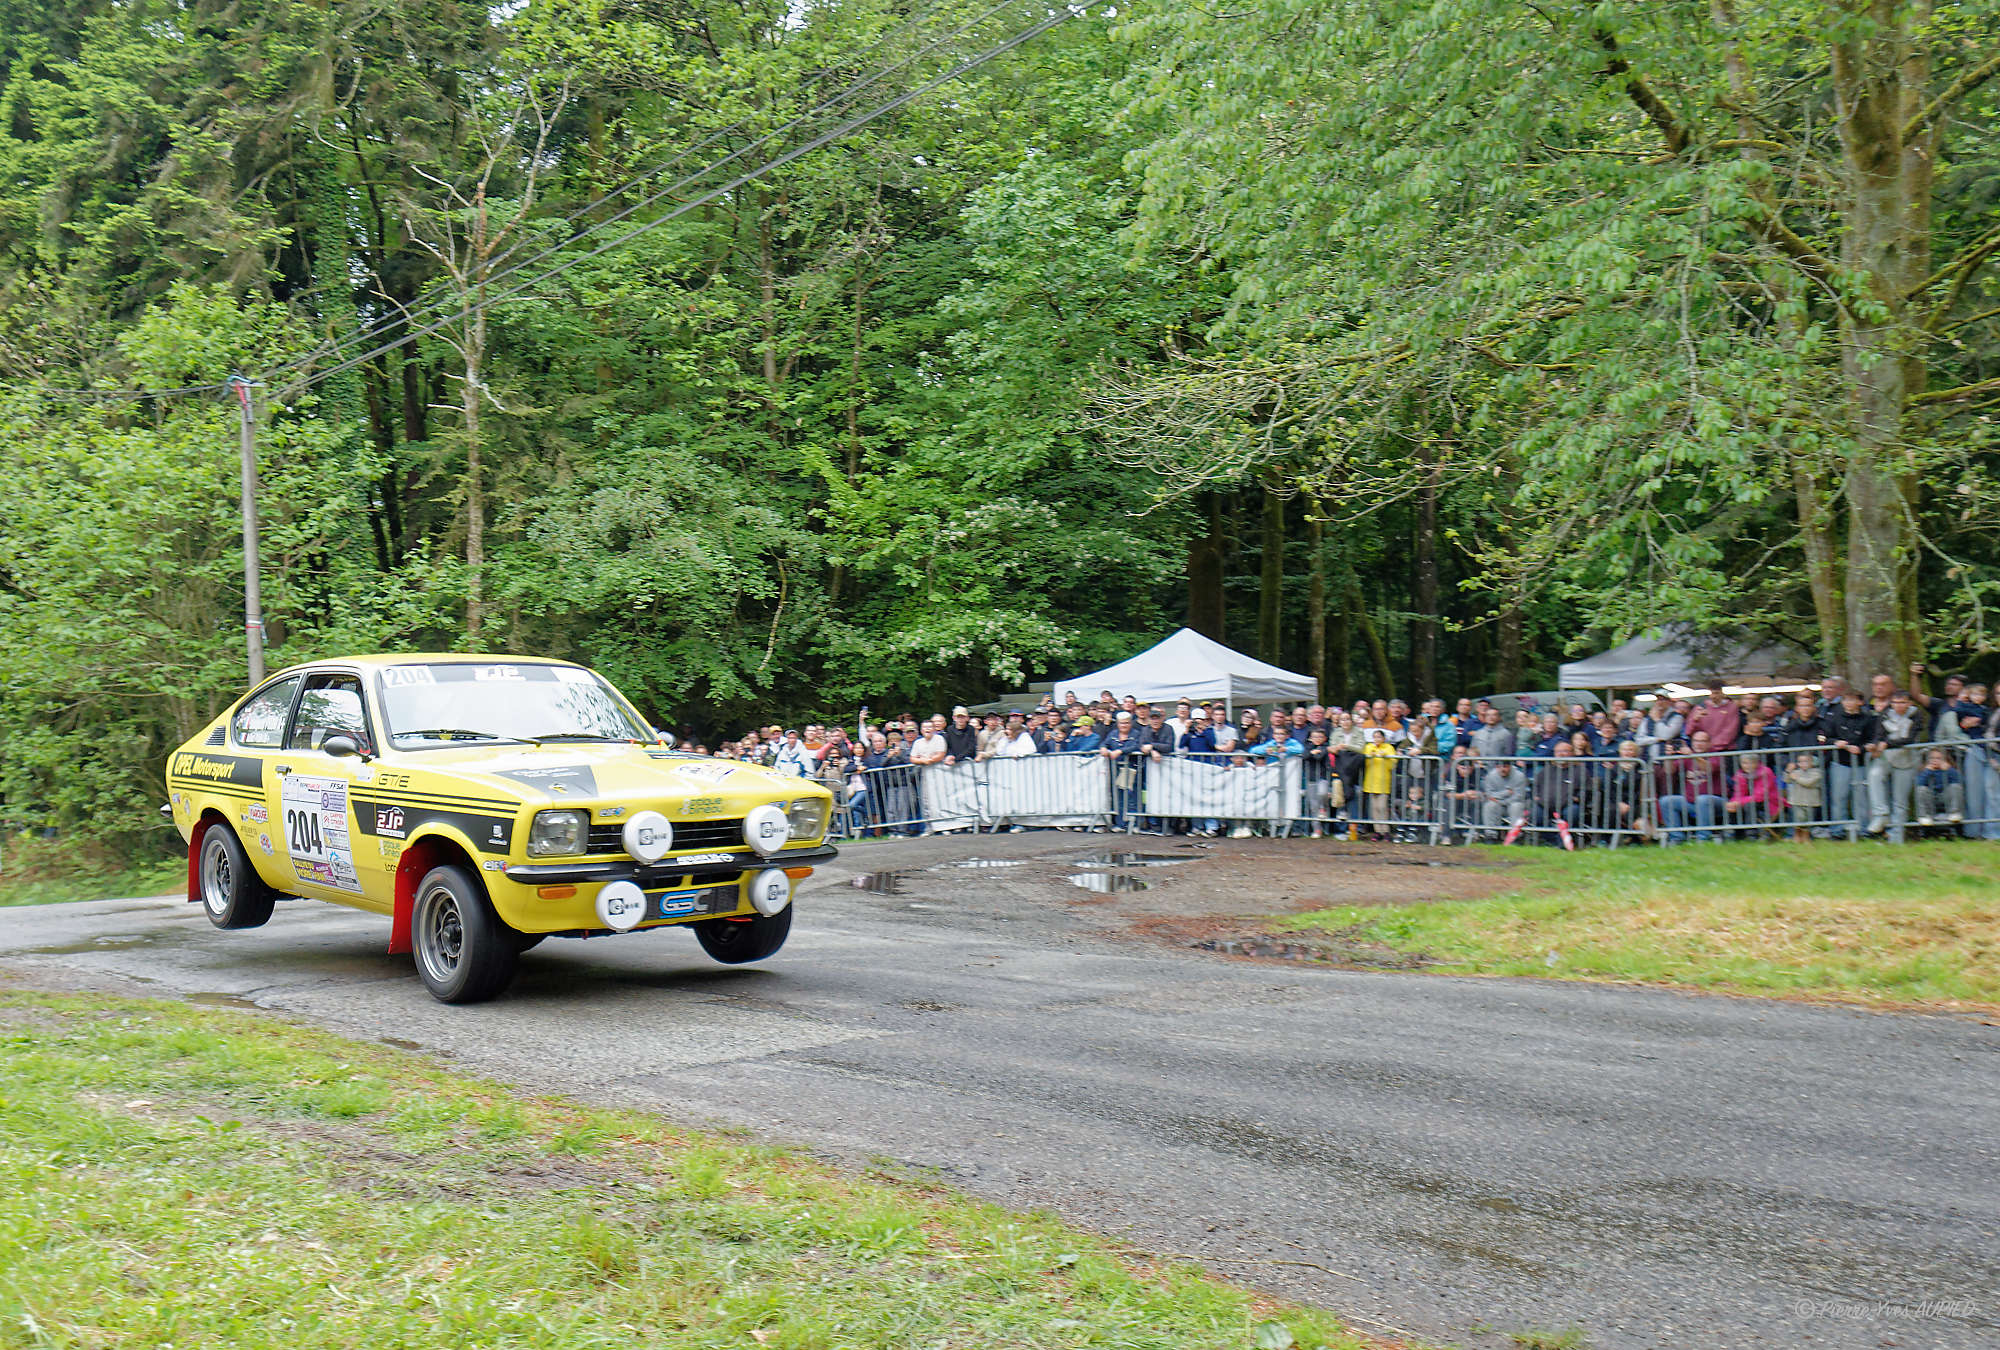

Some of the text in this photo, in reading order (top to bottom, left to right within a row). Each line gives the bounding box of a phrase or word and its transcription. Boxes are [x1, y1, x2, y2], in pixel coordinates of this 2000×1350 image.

[391, 668, 429, 686] 204
[174, 754, 236, 780] OPEL Motorsport
[378, 773, 410, 788] GTE
[376, 811, 404, 830] 2JP
[287, 808, 322, 855] 204
[483, 860, 504, 872] elf
